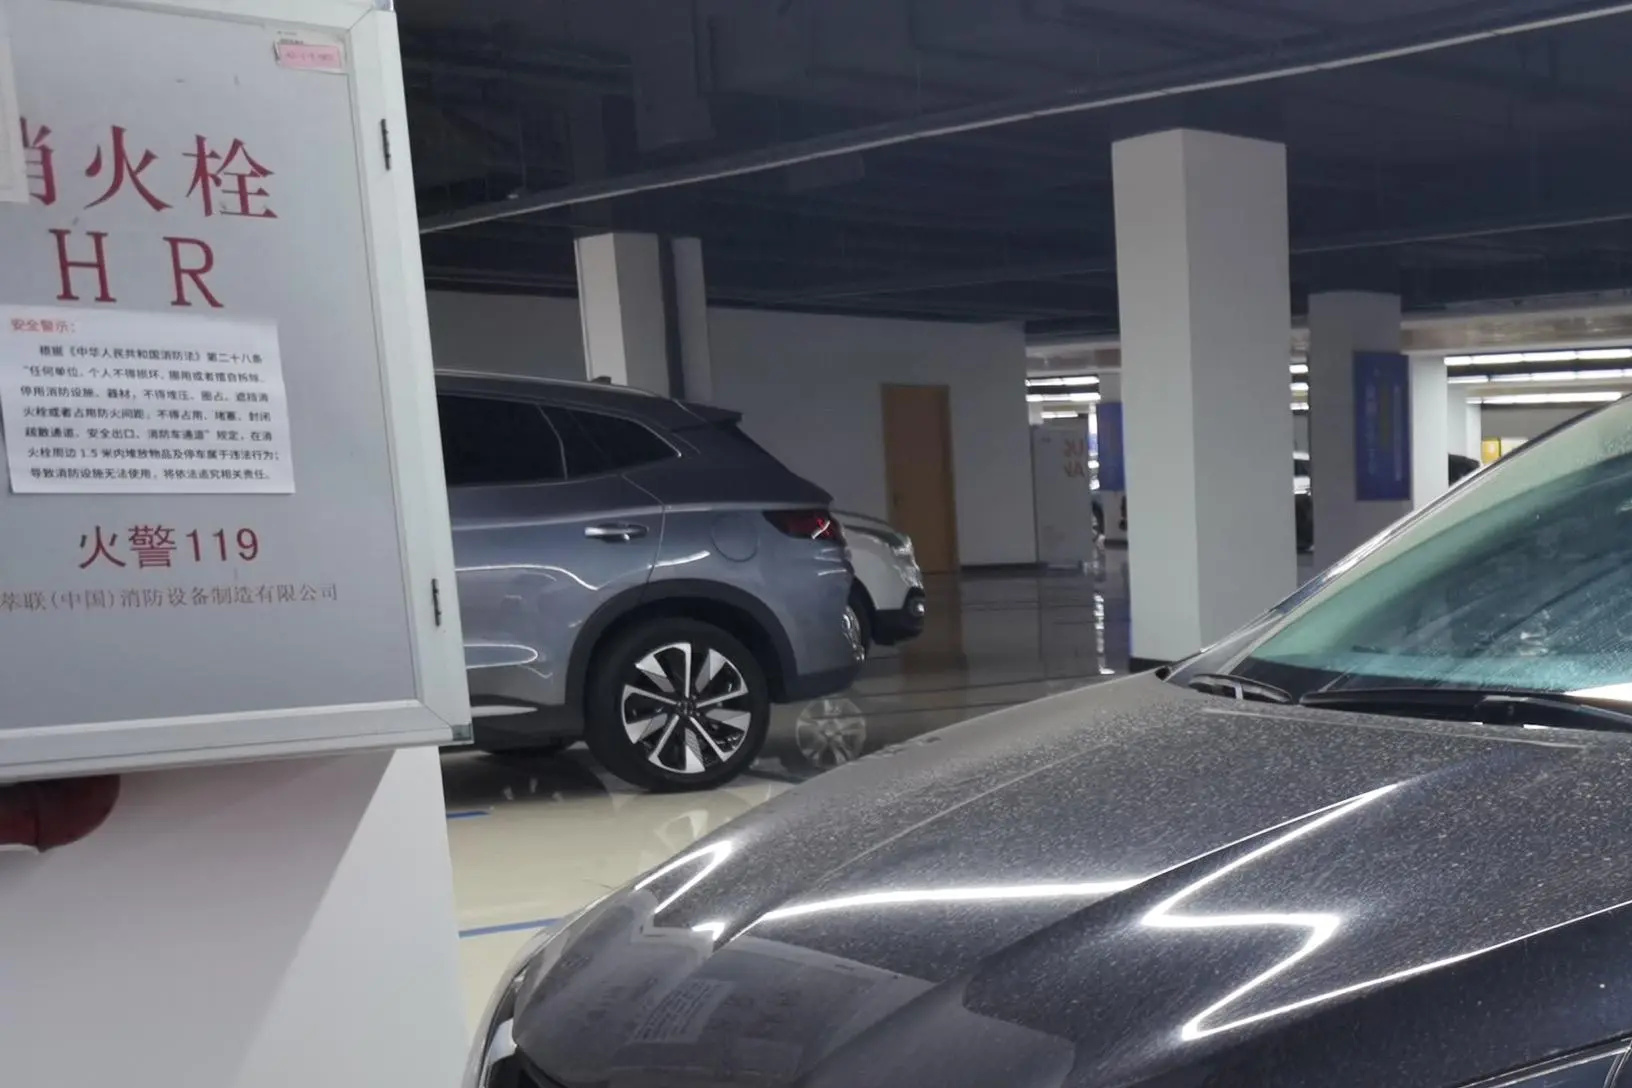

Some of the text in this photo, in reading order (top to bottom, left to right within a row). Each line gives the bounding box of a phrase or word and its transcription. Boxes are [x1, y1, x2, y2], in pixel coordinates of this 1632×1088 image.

[48, 228, 225, 308] H R
[78, 525, 260, 569] 火警119
